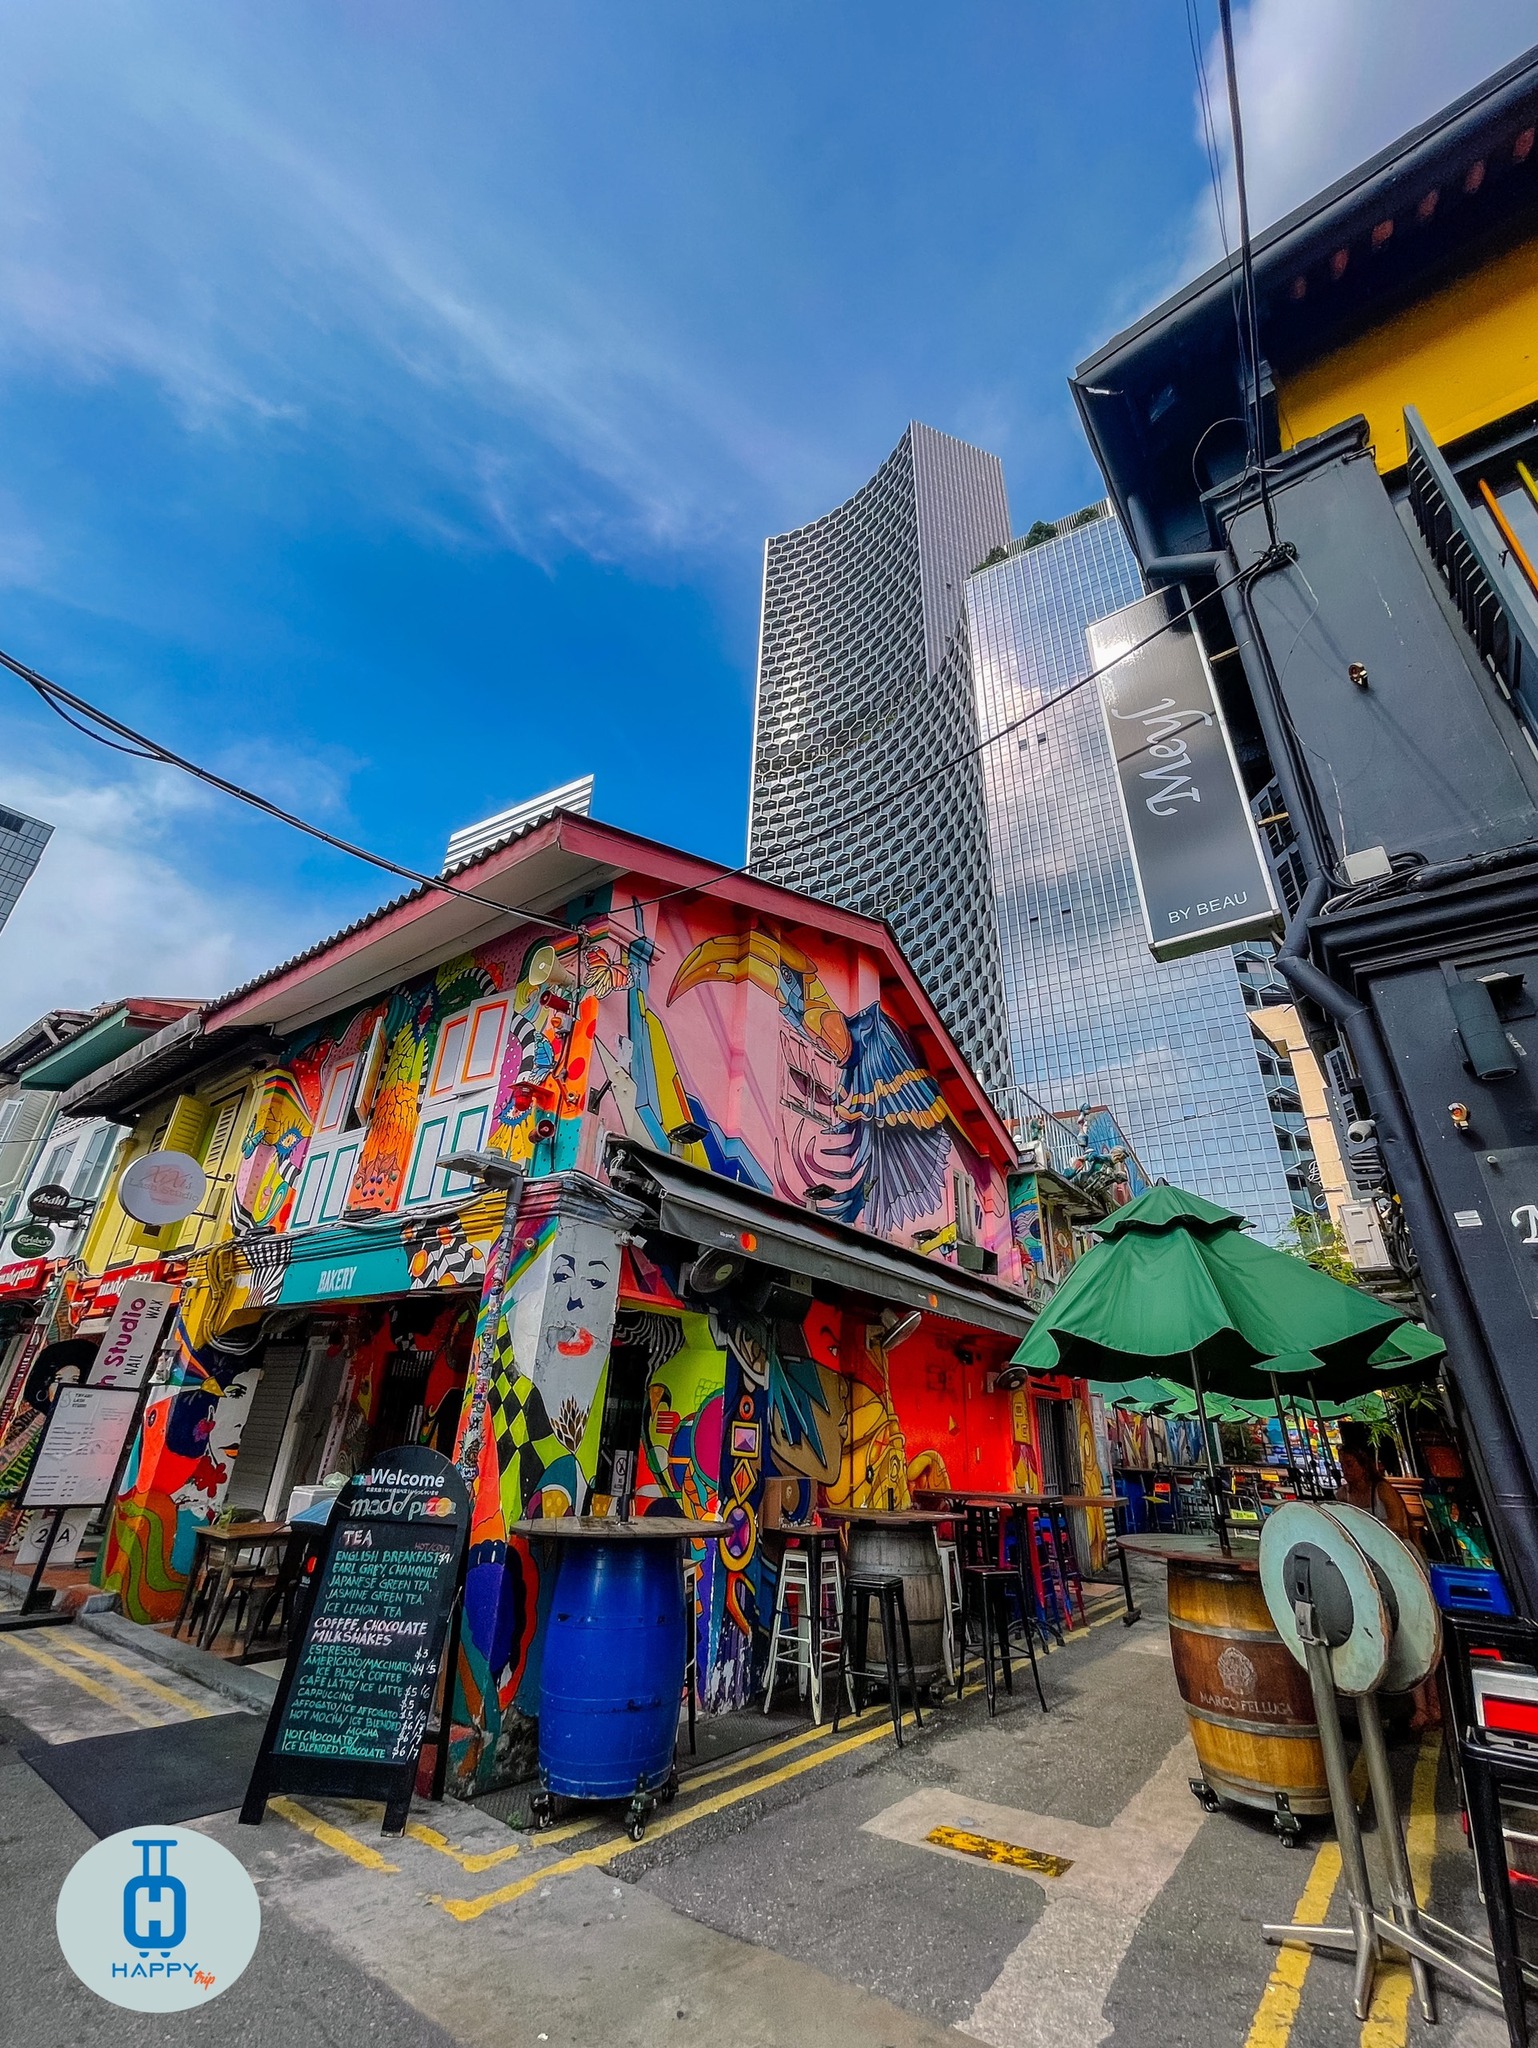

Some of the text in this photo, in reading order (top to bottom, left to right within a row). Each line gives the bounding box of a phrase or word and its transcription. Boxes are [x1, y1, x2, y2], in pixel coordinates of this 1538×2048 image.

[1168, 891, 1248, 924] BY BEAU
[33, 1192, 68, 1207] Asahi
[17, 1234, 53, 1248] Carlsberg
[316, 1266, 358, 1294] BAKERY
[145, 1299, 165, 1319] WAX
[104, 1298, 146, 1368] Studio
[123, 1354, 144, 1376] NAIL
[371, 1467, 445, 1488] Welcome
[342, 1529, 373, 1548] TEA
[335, 1550, 379, 1562] ENGLISH
[382, 1551, 440, 1564] BREAKFAST
[332, 1562, 356, 1574] EARL
[328, 1575, 378, 1589] JAPANESE
[378, 1578, 411, 1591] GREEN
[325, 1588, 369, 1600] JASMINE
[370, 1591, 403, 1603] GREEN
[323, 1601, 402, 1618] ICE LEMON TEA
[362, 1619, 428, 1635] CHOCOLATE
[311, 1629, 393, 1646] MILKSHAKES
[309, 1643, 429, 1660] ESPRESSO $3
[315, 1666, 402, 1683] ICE BLACK COFFEE
[360, 1682, 375, 1692] ICE
[378, 1684, 403, 1697] LATTE
[297, 1687, 415, 1711] CAPPUCCINO $5
[1199, 1690, 1295, 1715] MARCO FELLUGA
[289, 1709, 309, 1721] HOT
[349, 1716, 363, 1725] ICE
[366, 1717, 402, 1731] BLENDED
[357, 1705, 398, 1719] AFFOGATO
[346, 1726, 379, 1738] MOCHA
[281, 1740, 299, 1751] ICE
[299, 1741, 339, 1754] BLENDED
[340, 1746, 386, 1758] CHOCOLATE
